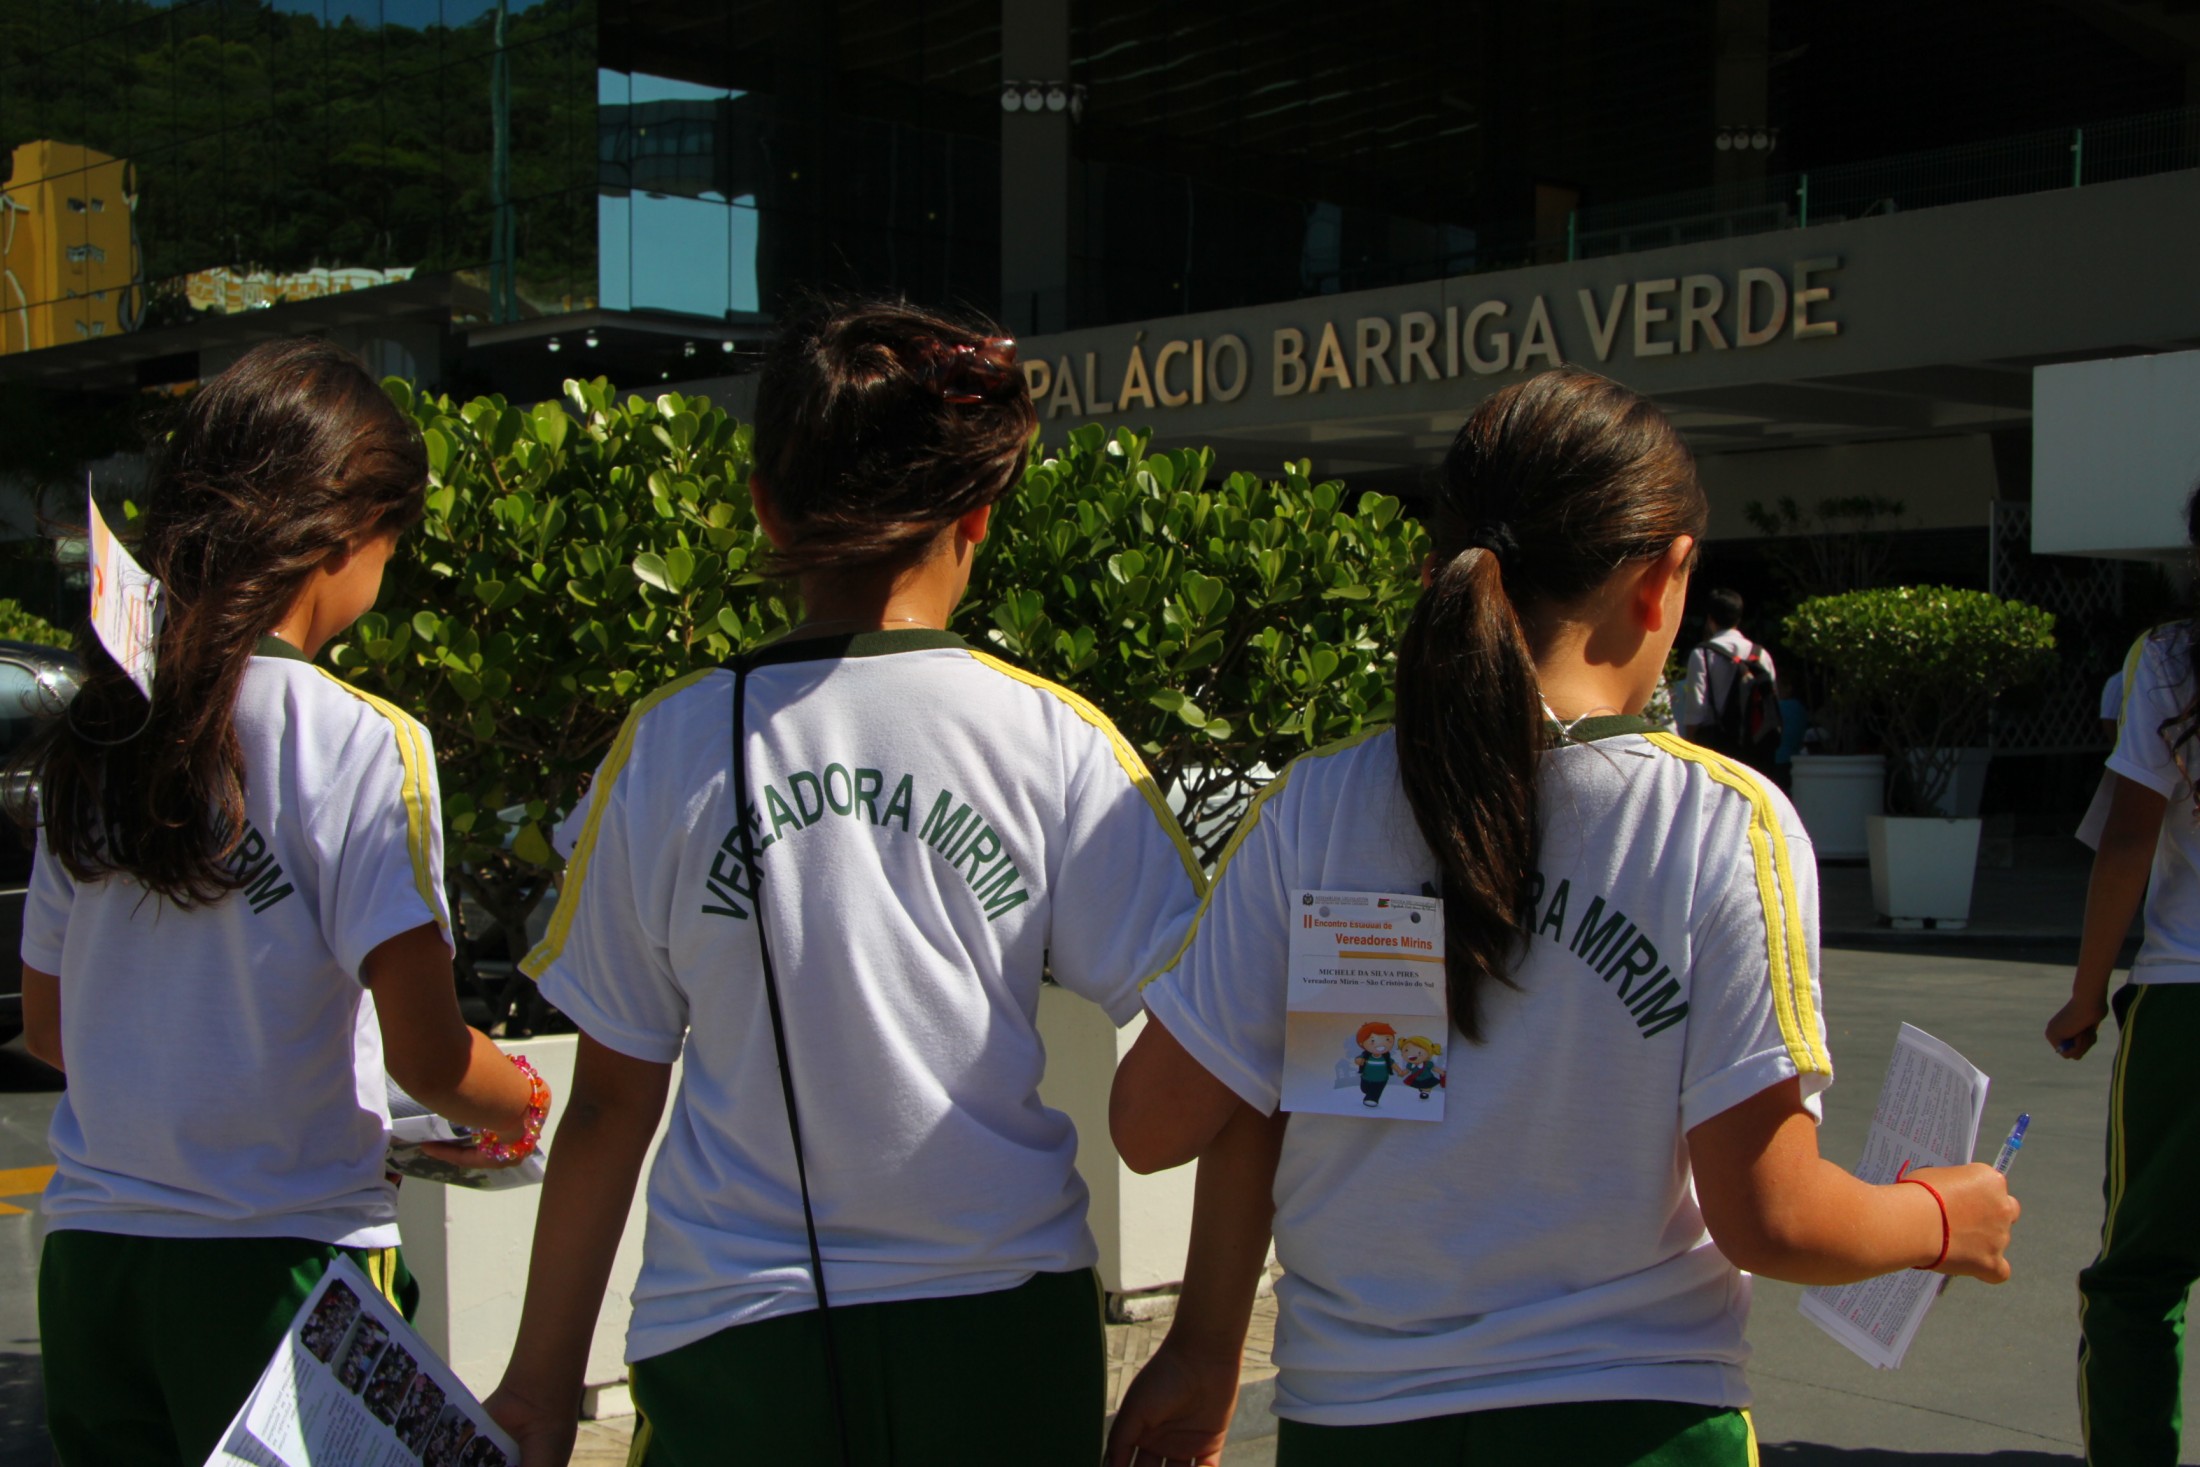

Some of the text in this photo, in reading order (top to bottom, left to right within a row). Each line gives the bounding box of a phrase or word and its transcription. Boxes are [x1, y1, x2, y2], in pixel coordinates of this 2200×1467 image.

[1023, 255, 1839, 418] PALÁCIO BARRIGA VERDE
[918, 788, 1029, 922] MIRIM
[1304, 914, 1312, 929] II
[1314, 919, 1348, 928] Encontro
[1383, 921, 1393, 930] de
[1335, 933, 1433, 950] Vereadores Mirins
[1319, 968, 1356, 976] MICHELE
[1396, 970, 1420, 978] PIRES
[1569, 895, 1689, 1039] MIRIM
[1303, 977, 1338, 985] Vereadora
